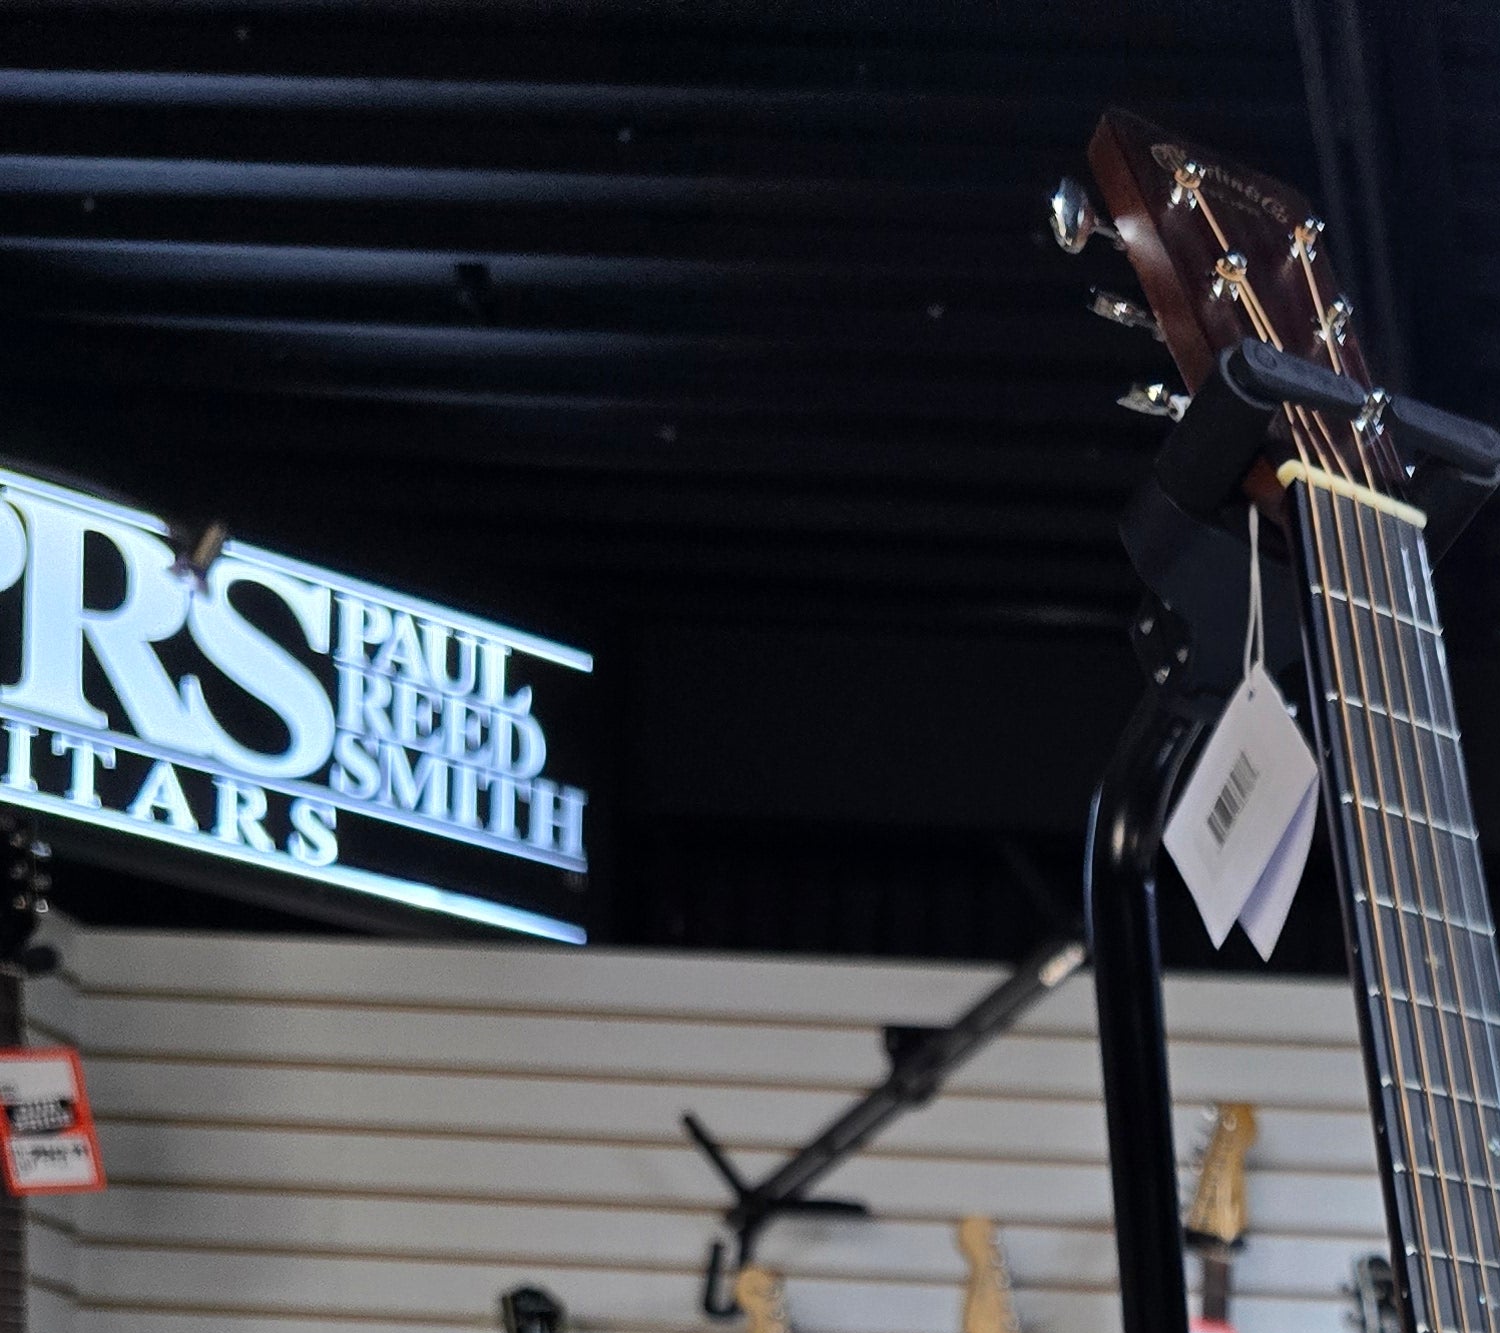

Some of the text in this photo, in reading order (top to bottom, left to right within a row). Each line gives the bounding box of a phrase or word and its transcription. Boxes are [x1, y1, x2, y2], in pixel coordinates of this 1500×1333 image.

[0, 489, 334, 778] RS
[333, 594, 532, 716] PAUL
[333, 664, 547, 780] REED
[330, 733, 588, 857] SMITH
